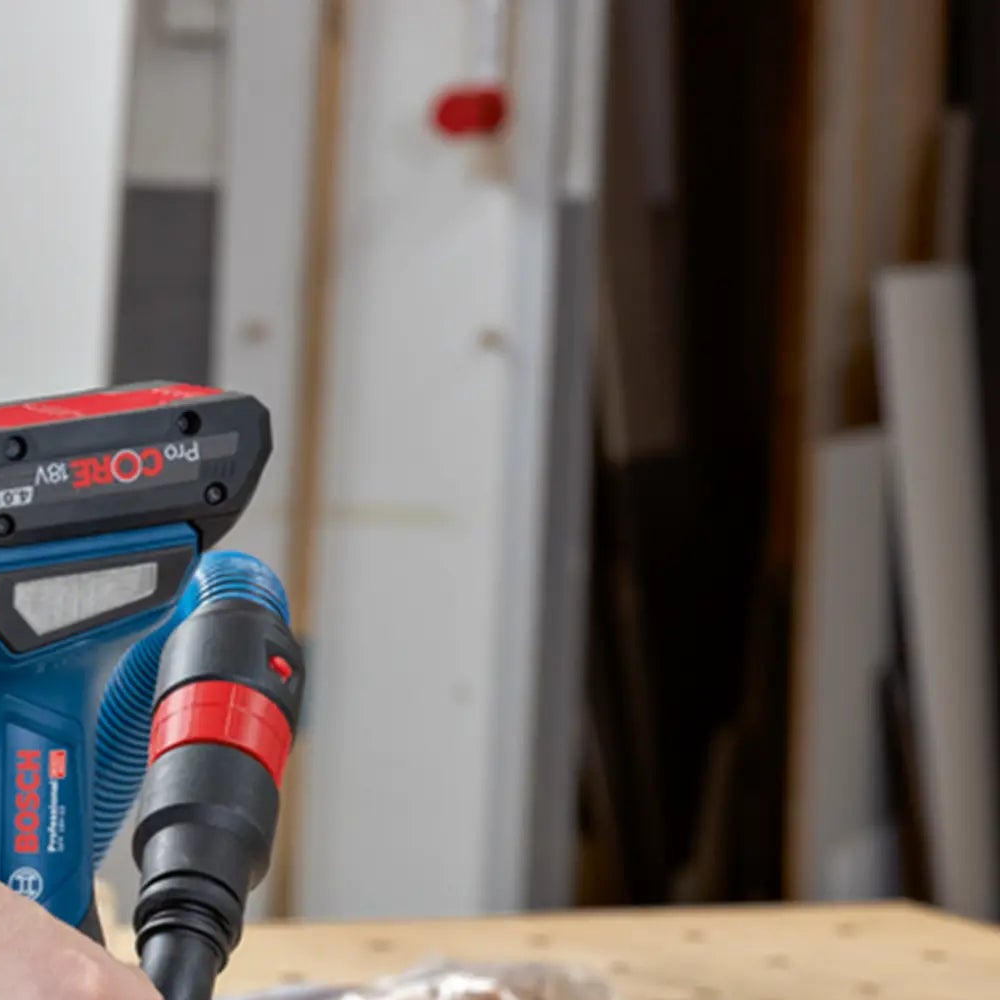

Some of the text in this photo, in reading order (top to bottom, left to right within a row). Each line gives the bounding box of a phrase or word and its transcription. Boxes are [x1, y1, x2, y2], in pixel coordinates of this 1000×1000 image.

[34, 440, 199, 489] Pro CORE 18V
[14, 750, 42, 853] BOSCH
